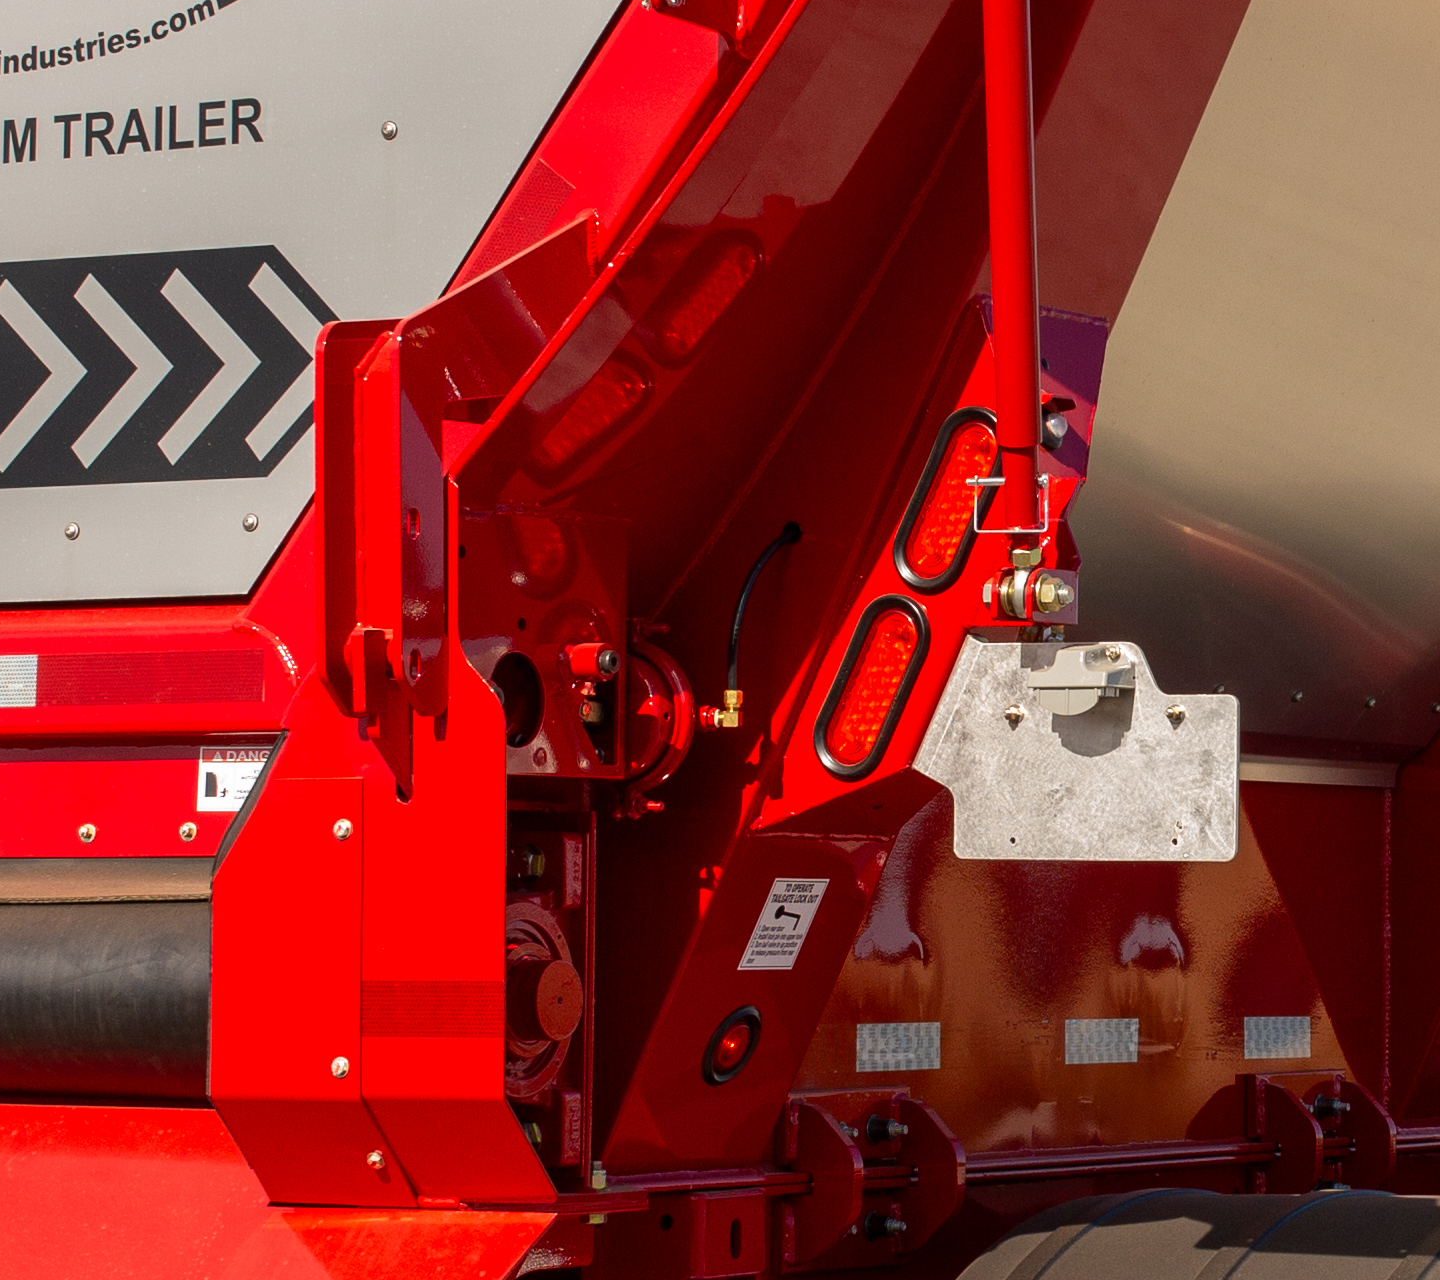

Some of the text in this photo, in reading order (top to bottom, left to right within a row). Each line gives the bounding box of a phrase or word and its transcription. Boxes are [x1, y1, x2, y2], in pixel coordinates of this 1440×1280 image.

[55, 97, 265, 161] TRAILER
[226, 751, 270, 762] DANG
[785, 884, 815, 893] TO OPERATE
[771, 894, 819, 903] TAILGATE LOCK OUT
